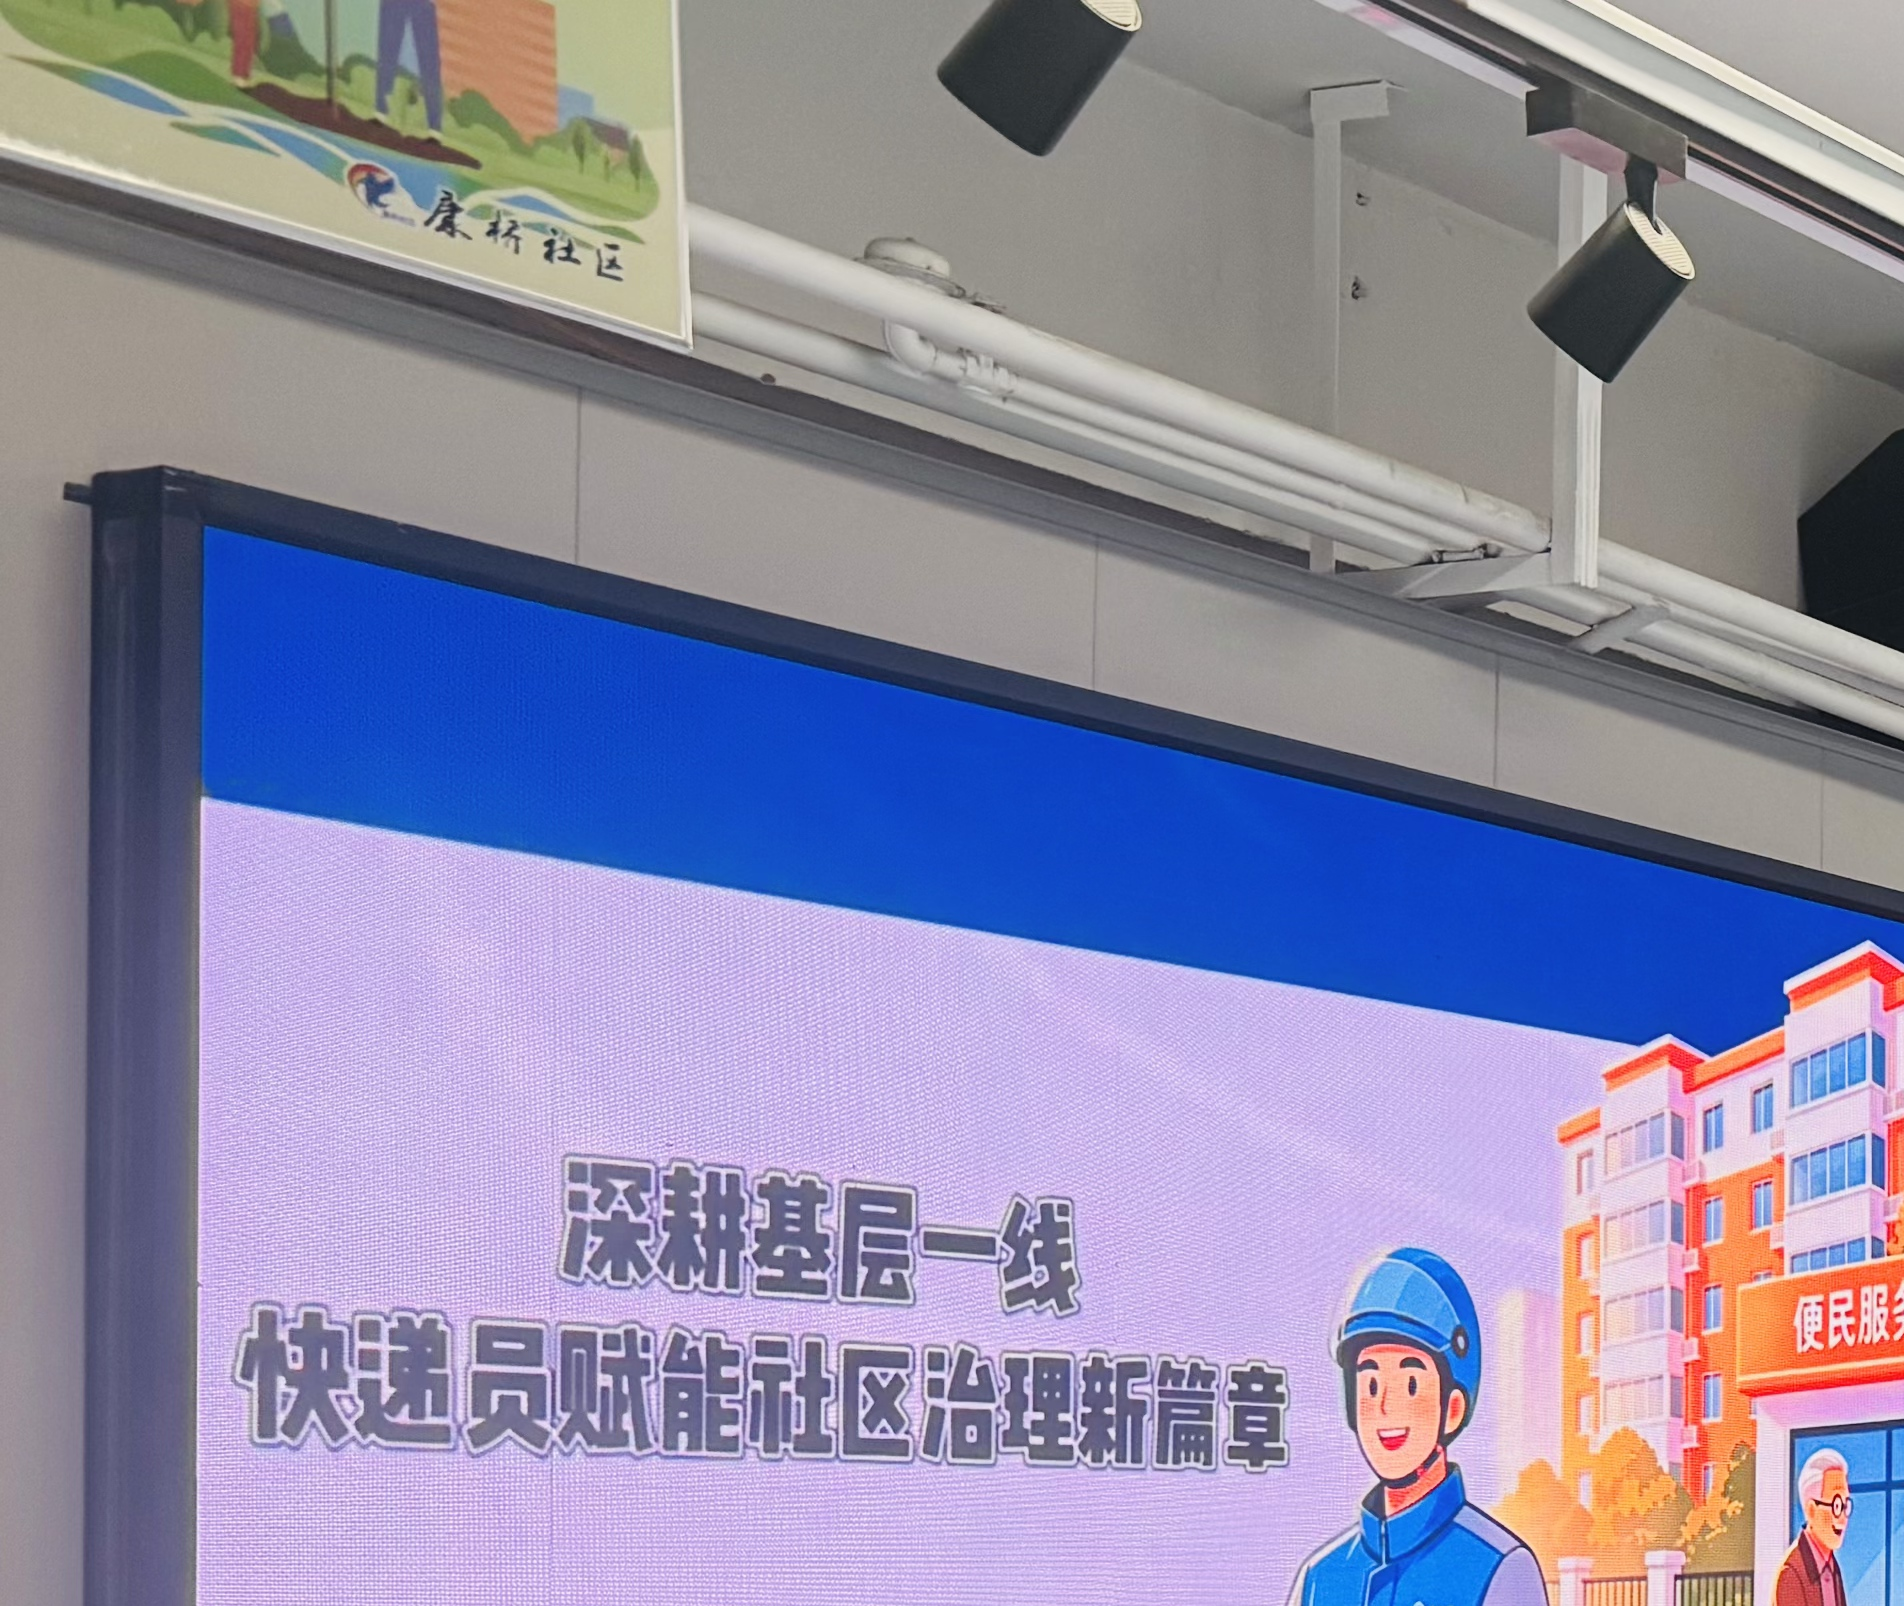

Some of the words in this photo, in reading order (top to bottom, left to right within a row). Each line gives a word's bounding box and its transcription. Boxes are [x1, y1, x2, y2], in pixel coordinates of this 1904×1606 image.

[559, 1154, 1081, 1316] 深耕基层一线
[234, 1303, 1290, 1472] 快递员赋能社区治理新篇章
